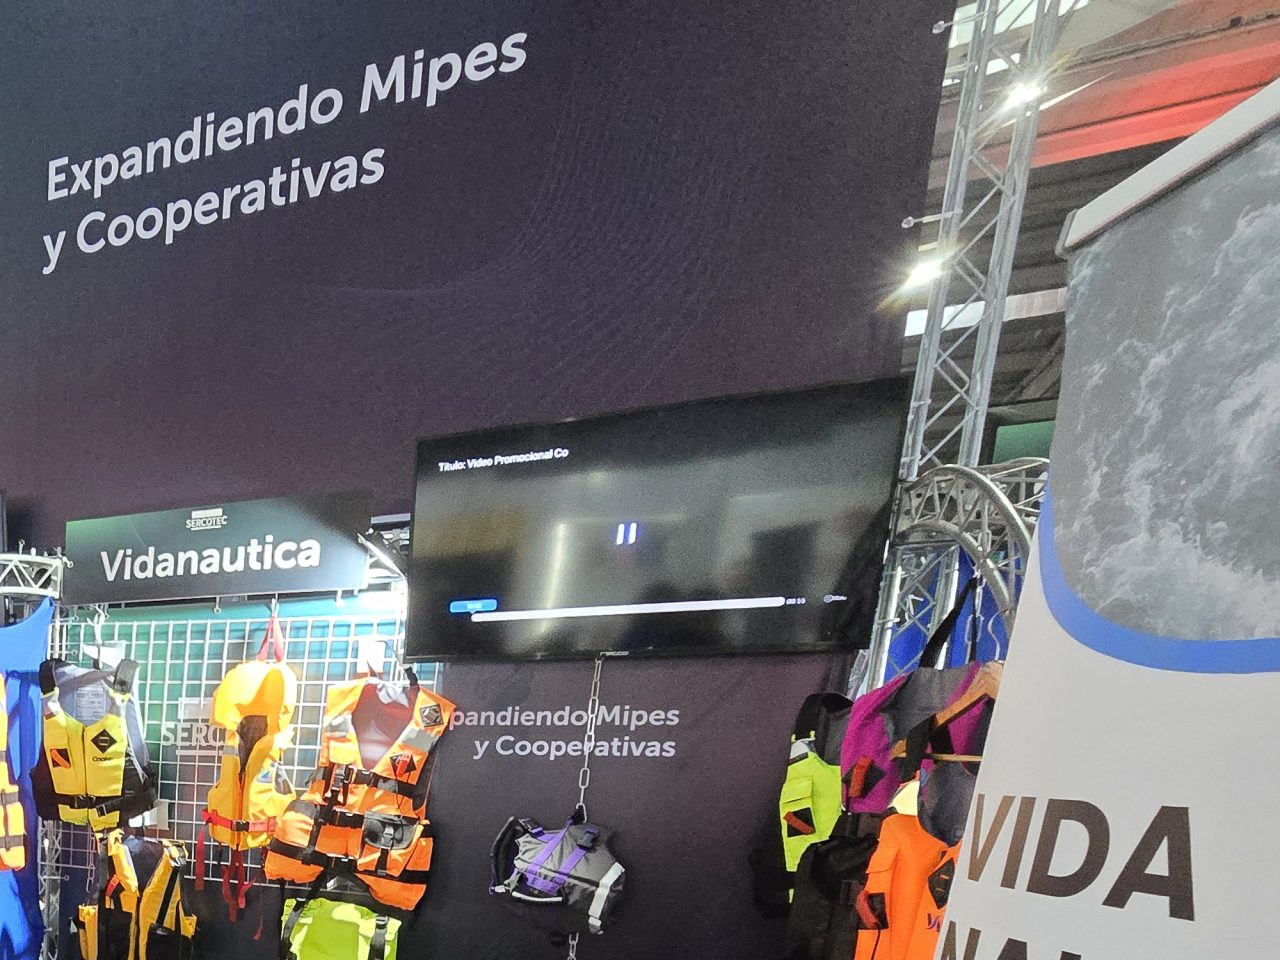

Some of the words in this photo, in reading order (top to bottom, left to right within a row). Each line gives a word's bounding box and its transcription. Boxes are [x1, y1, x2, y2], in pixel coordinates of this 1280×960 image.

[46, 83, 343, 202] Expandiendo
[357, 31, 528, 113] Mipes
[42, 232, 67, 274] y
[75, 147, 386, 254] Cooperativas
[494, 449, 553, 466] Promocional
[554, 447, 569, 458] Co
[185, 515, 228, 529] SERCOTEC
[100, 534, 321, 582] Vidanautica
[448, 705, 588, 731] pandiendo
[596, 705, 680, 731] Mipes
[161, 721, 226, 747] SERC
[473, 738, 489, 760] y
[495, 735, 676, 760] Cooperativas
[967, 793, 1196, 922] VIDA
